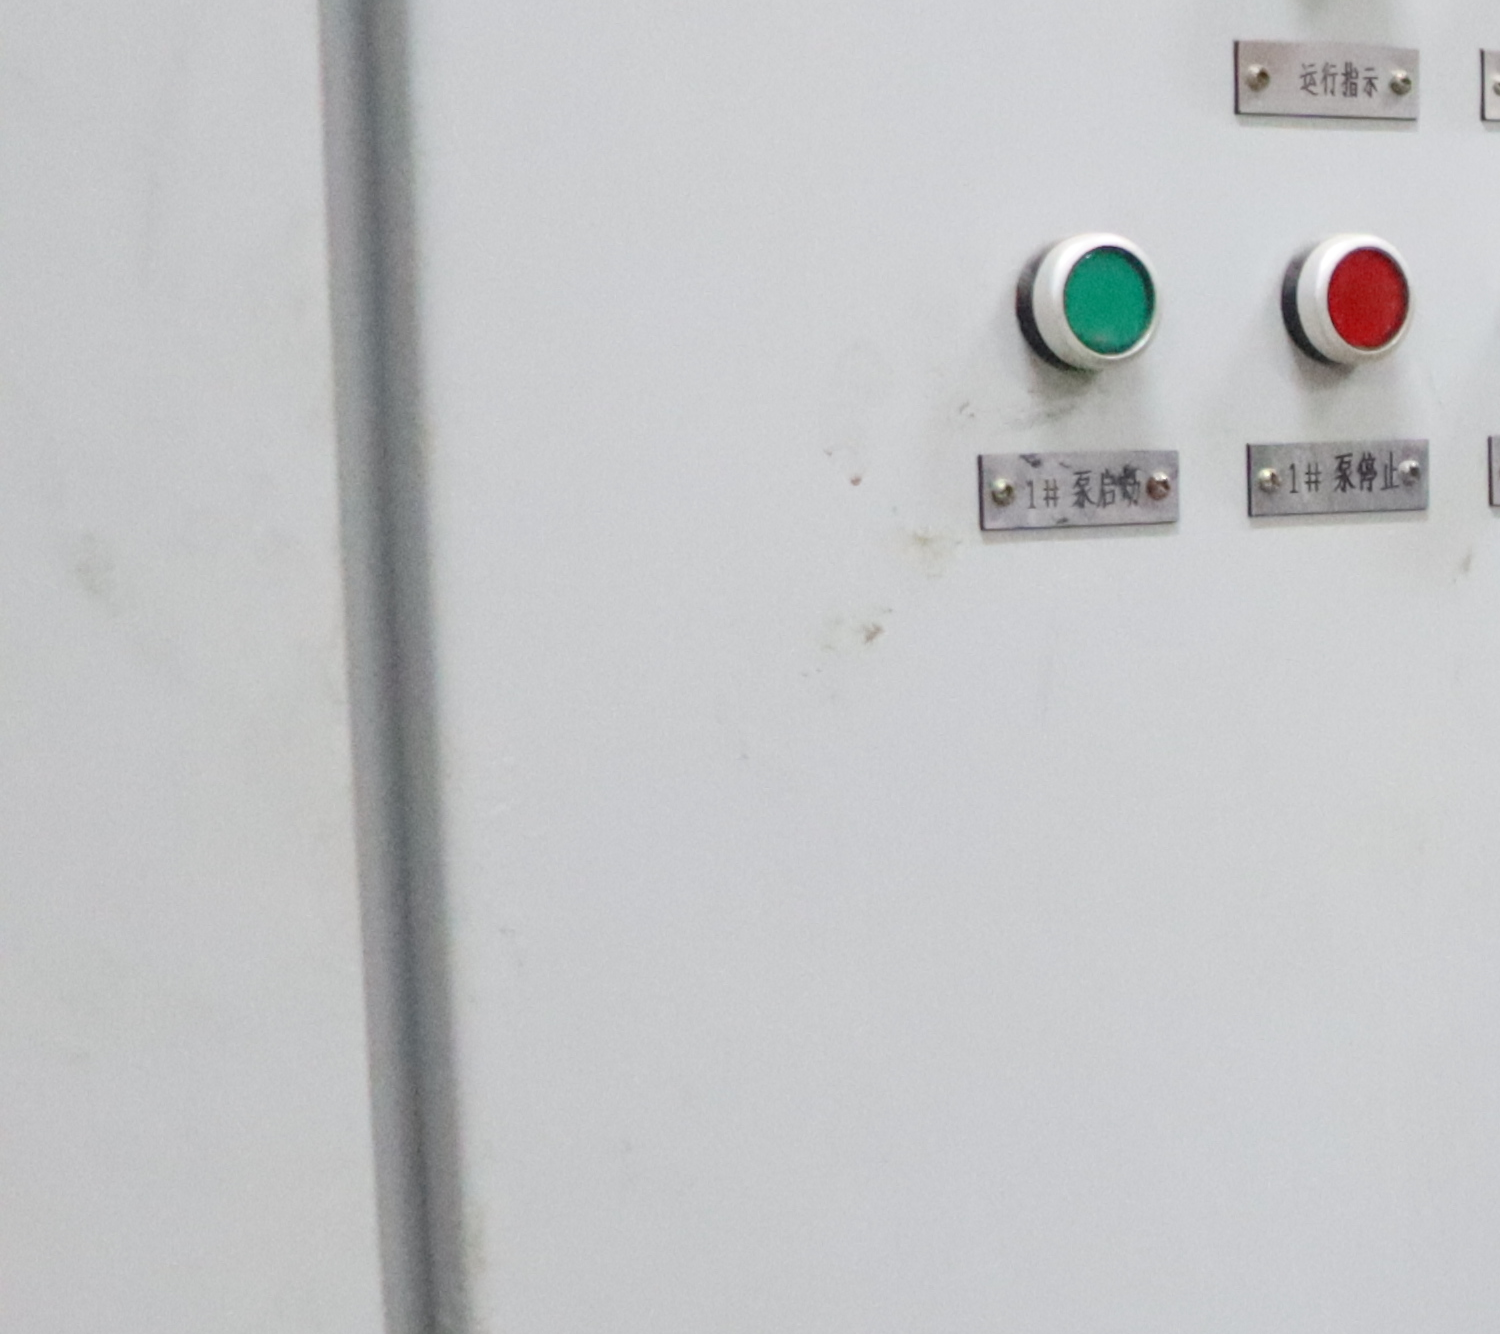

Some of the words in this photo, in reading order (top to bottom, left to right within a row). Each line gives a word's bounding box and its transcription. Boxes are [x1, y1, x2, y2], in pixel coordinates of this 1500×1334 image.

[1298, 61, 1380, 99] 运行指示
[1288, 462, 1322, 494] 1#
[1332, 450, 1400, 493] 泵停止
[1026, 479, 1060, 509] 1#
